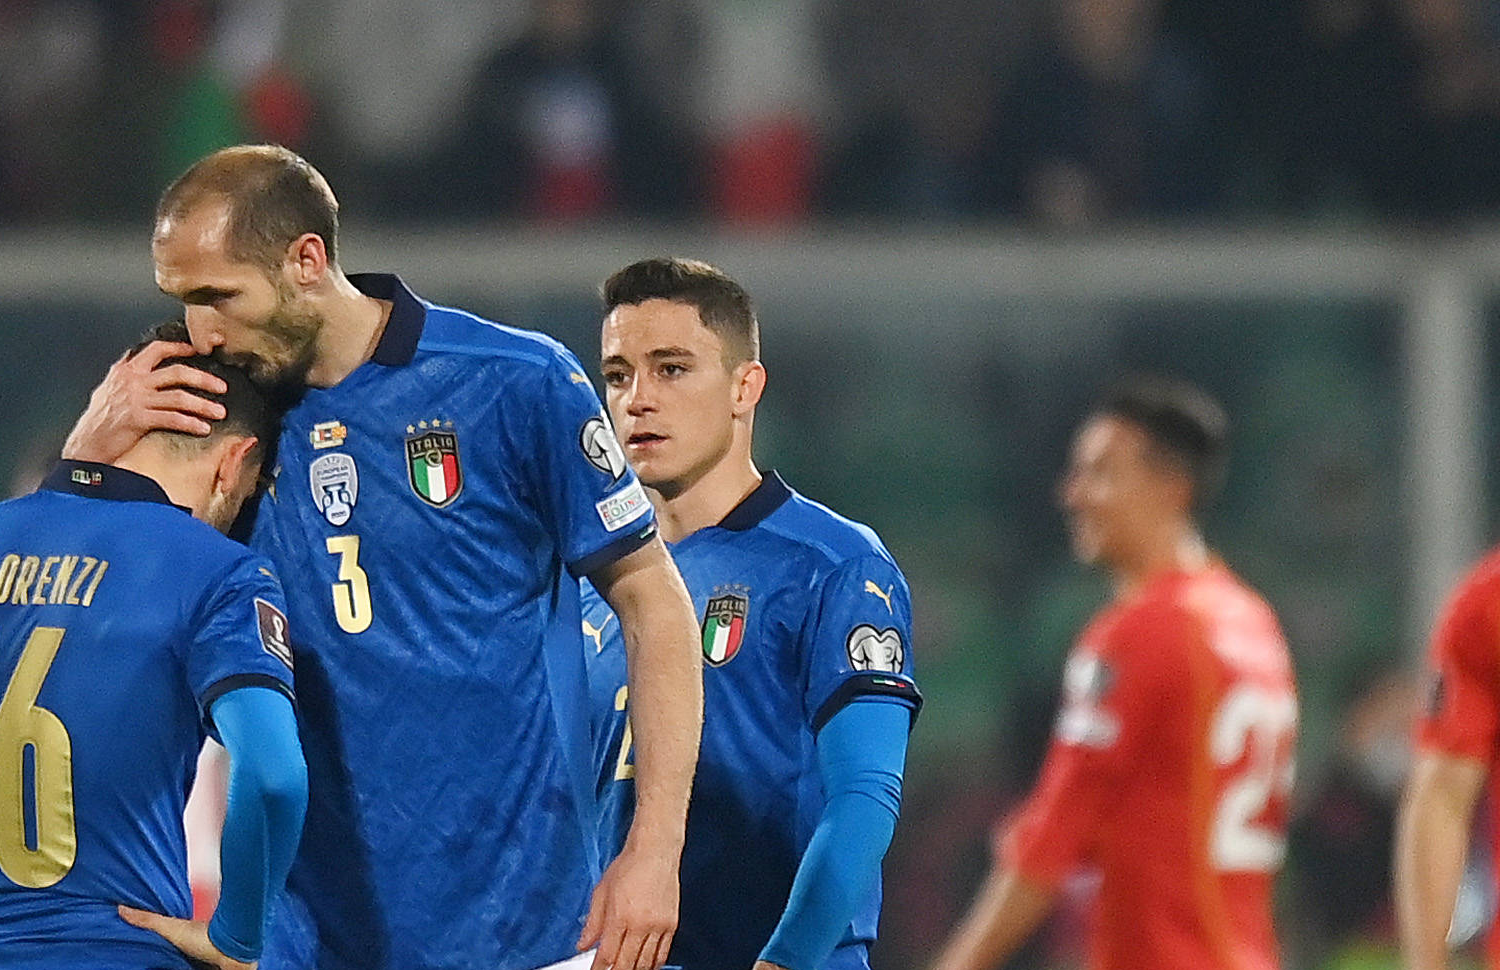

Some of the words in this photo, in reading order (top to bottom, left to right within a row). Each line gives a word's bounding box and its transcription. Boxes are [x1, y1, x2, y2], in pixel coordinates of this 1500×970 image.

[409, 437, 454, 453] ITALIA
[326, 535, 373, 634] 3
[709, 600, 745, 611] ITALIA
